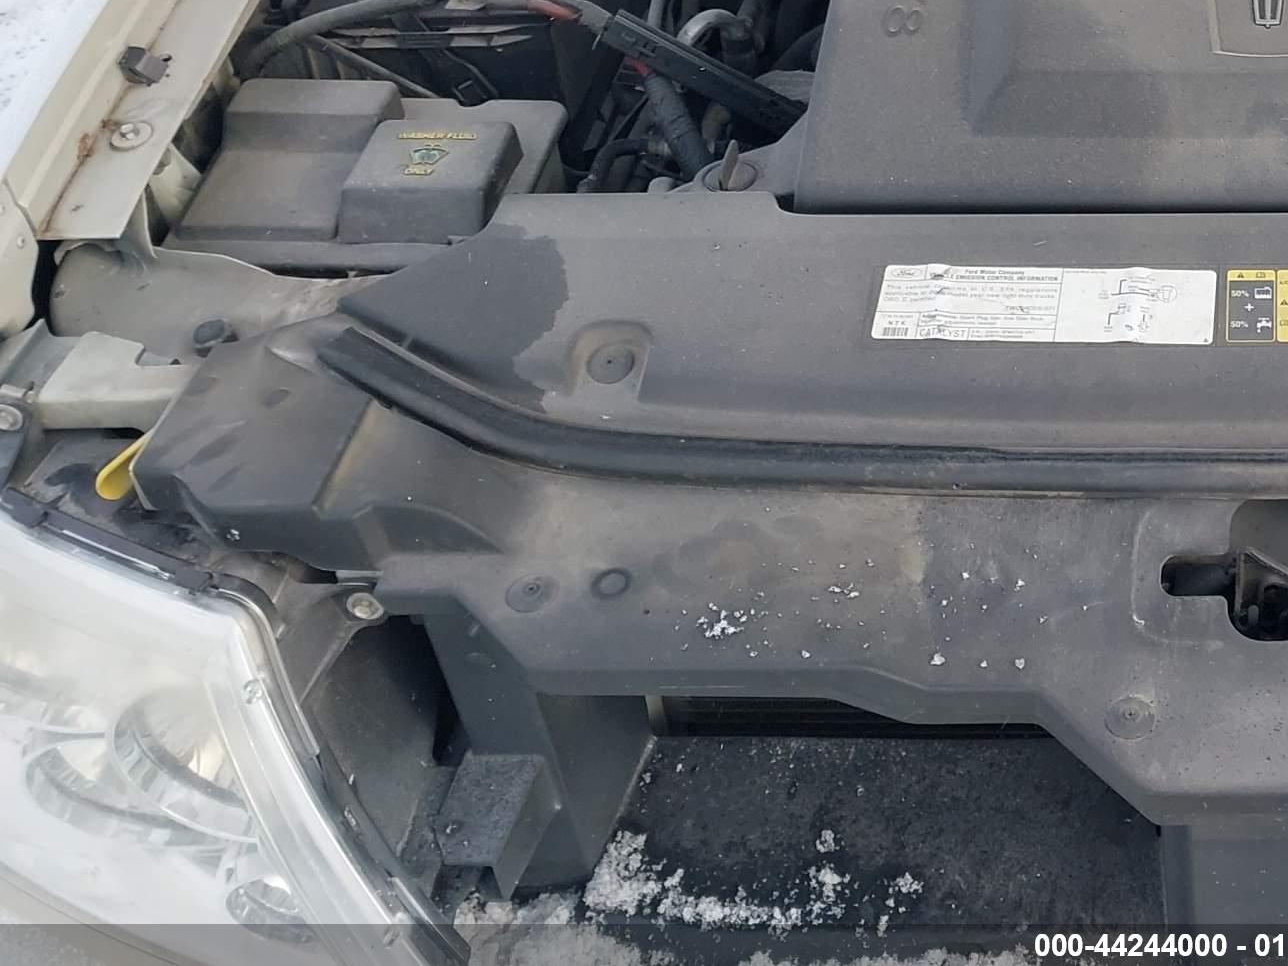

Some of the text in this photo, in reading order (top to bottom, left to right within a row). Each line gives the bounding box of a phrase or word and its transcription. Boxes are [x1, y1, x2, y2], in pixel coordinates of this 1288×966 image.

[447, 132, 477, 140] FLUID
[403, 167, 434, 176] ONLY
[1231, 290, 1250, 298] 50%
[1230, 320, 1249, 329] 50%
